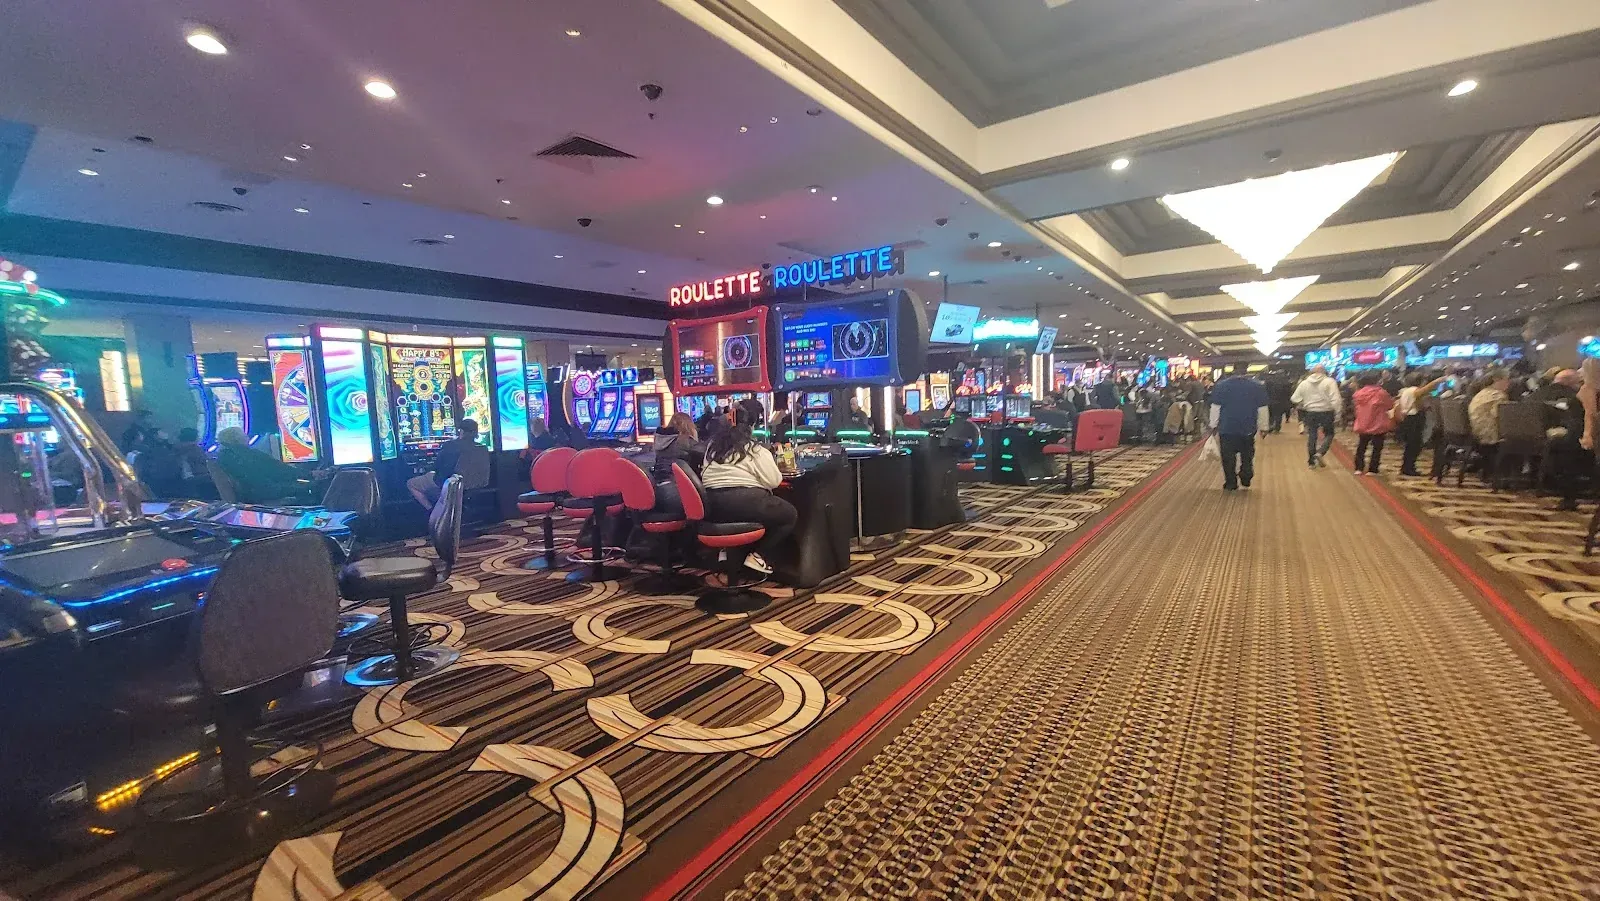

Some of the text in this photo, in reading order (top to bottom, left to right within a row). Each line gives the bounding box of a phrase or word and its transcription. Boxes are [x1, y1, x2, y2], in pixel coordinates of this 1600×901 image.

[774, 246, 893, 288] ROULETTE
[670, 270, 761, 307] ROULETTE
[402, 348, 427, 358] HAPPY
